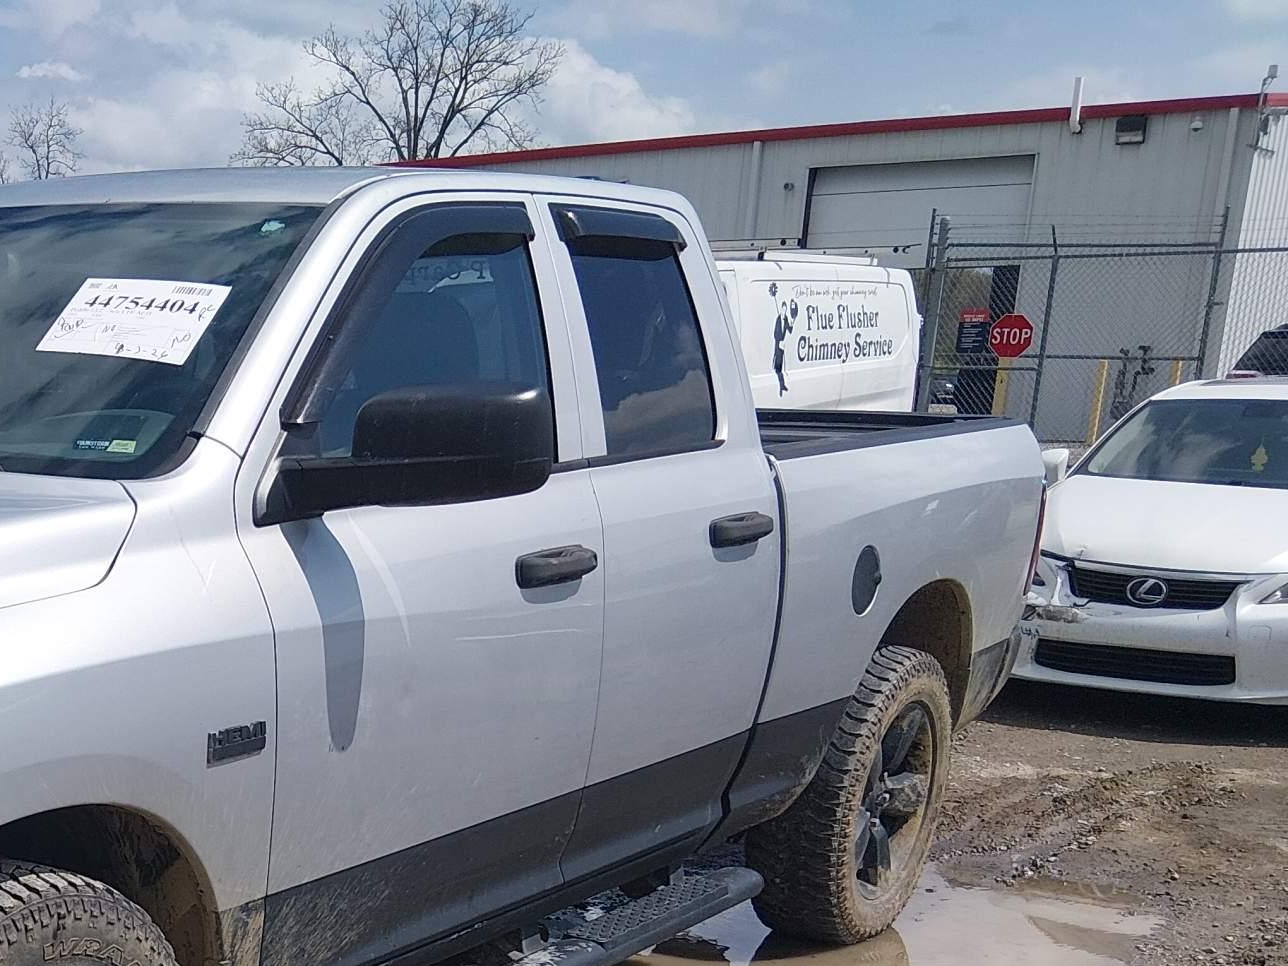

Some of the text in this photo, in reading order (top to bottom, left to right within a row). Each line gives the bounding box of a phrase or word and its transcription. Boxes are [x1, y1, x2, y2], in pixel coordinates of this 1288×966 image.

[84, 294, 201, 315] 44754404
[806, 304, 879, 332] Flue Flusher
[797, 332, 893, 363] Chimney Service
[991, 328, 1031, 345] STOP
[207, 720, 266, 748] HEMI
